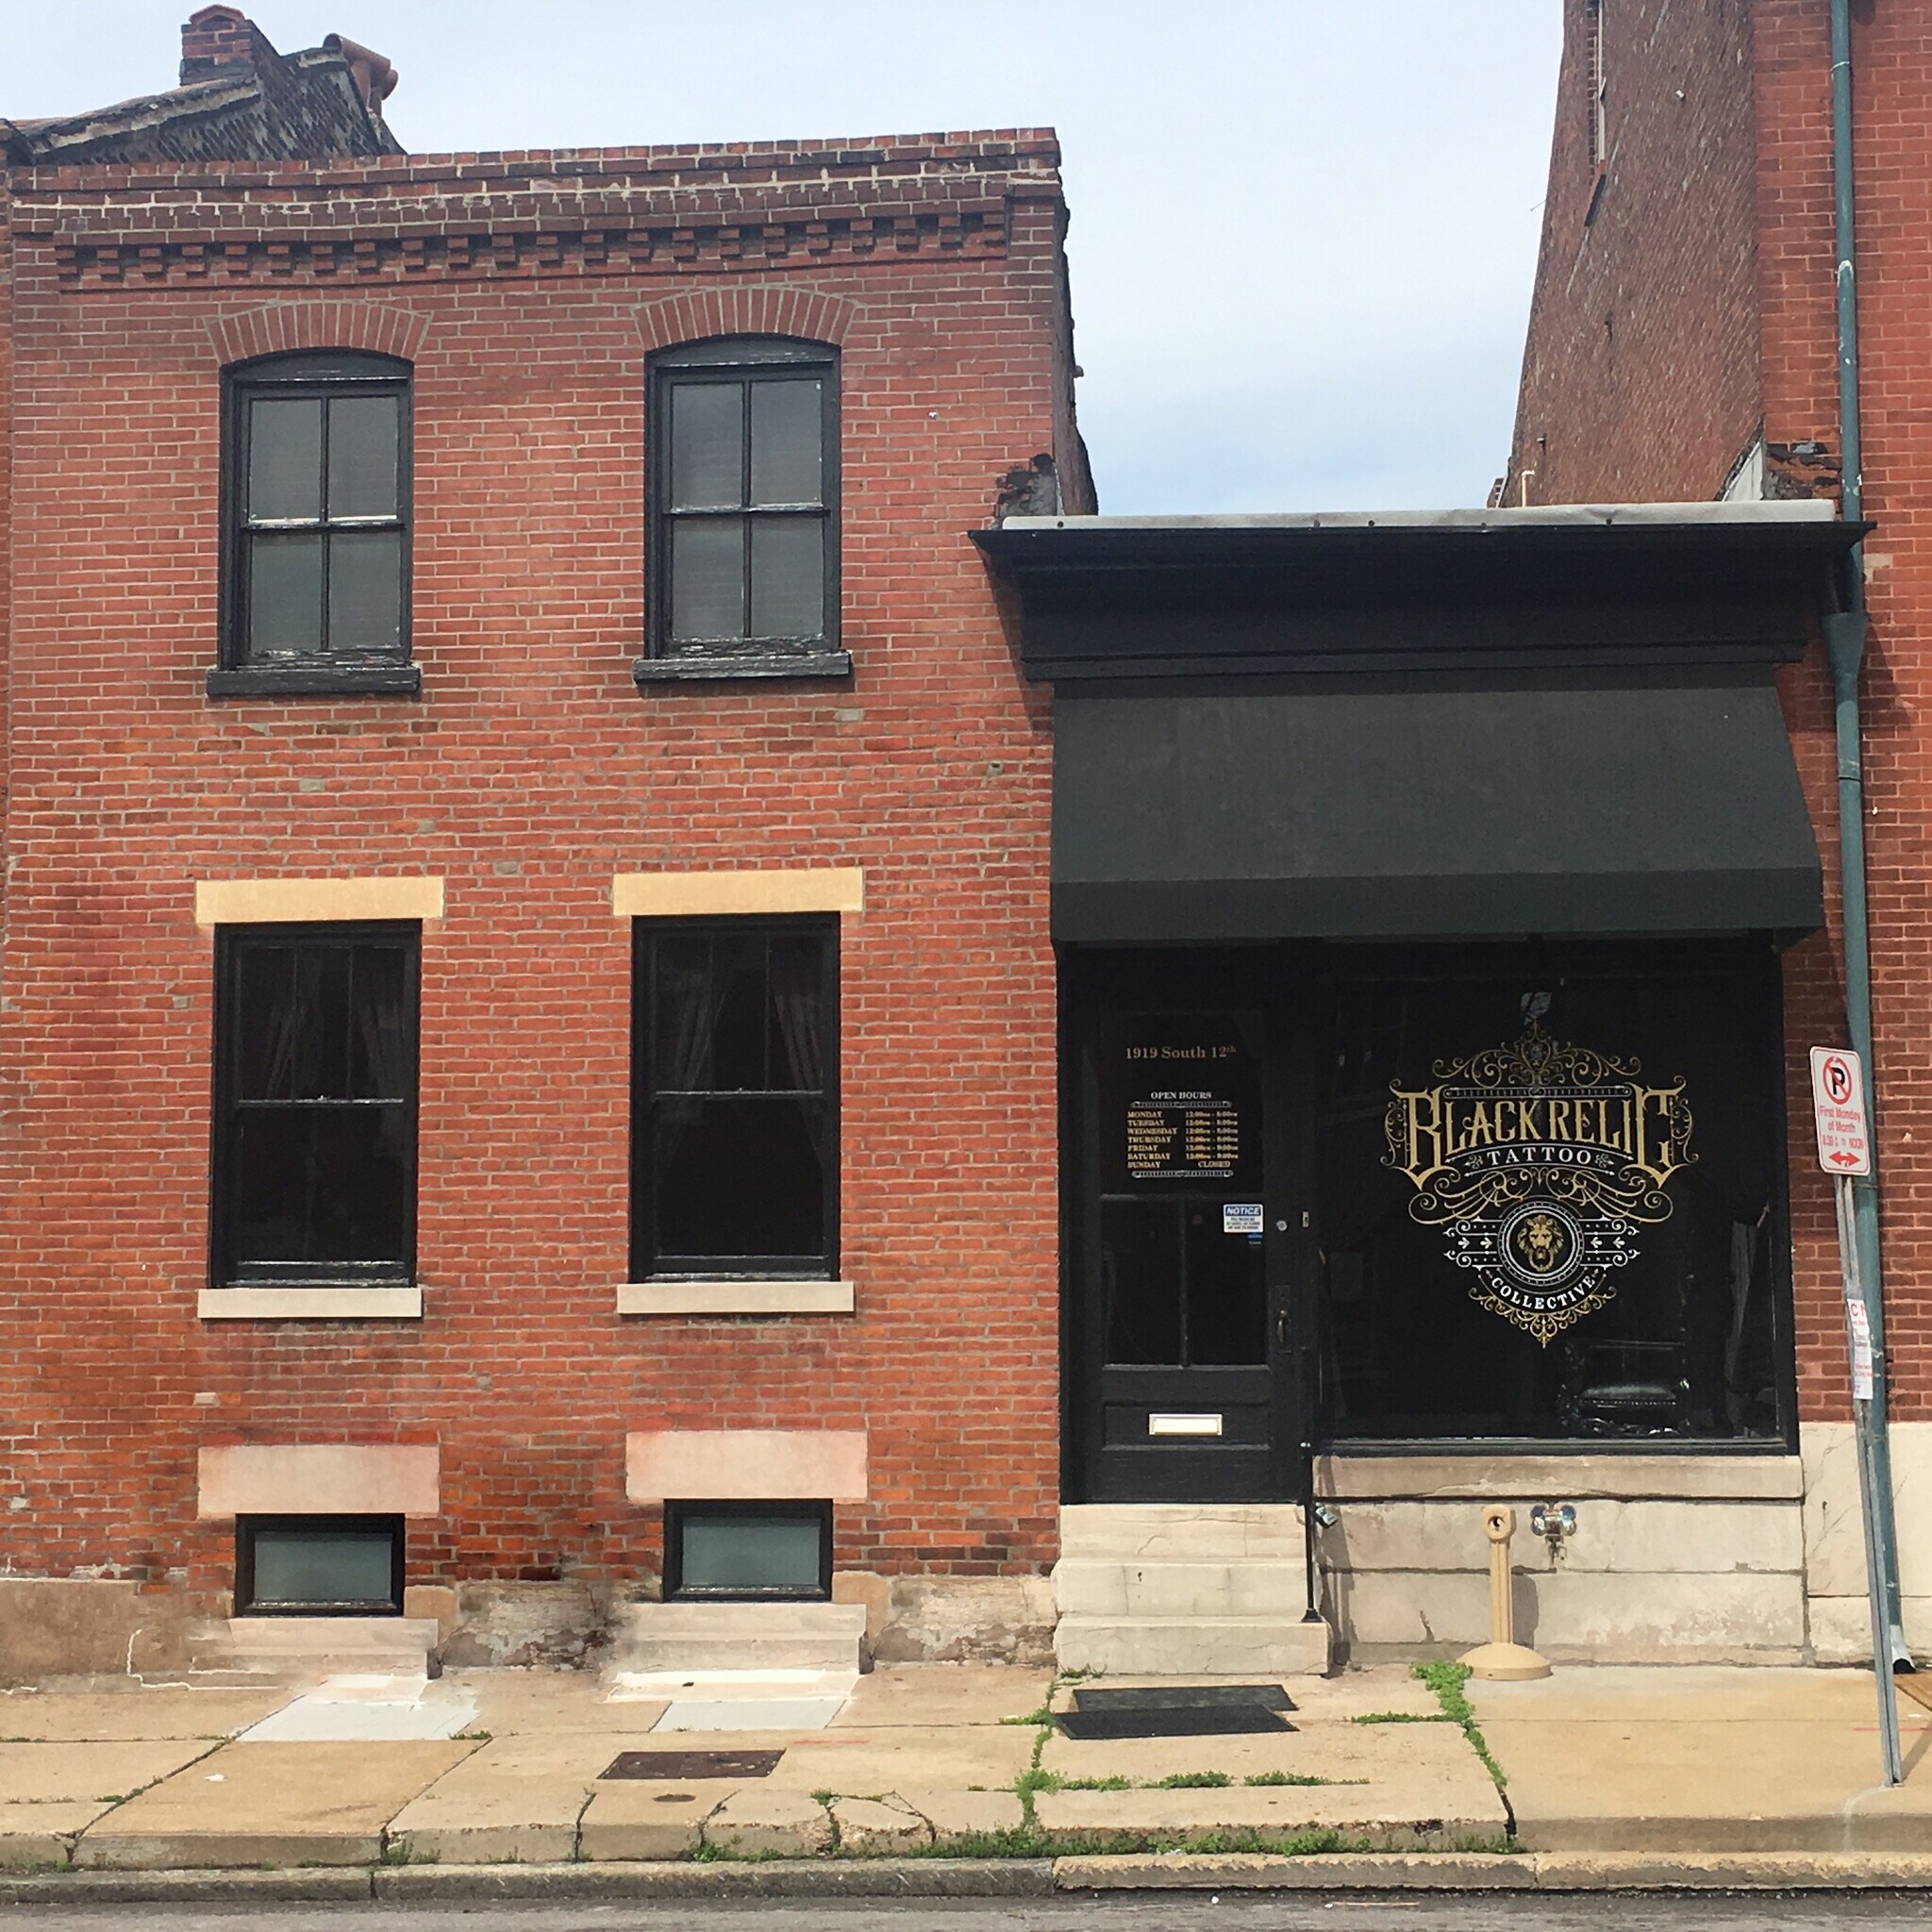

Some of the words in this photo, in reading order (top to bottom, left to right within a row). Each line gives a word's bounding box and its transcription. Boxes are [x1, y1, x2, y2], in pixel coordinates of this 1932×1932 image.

[1125, 1047, 1158, 1059] 1919
[1161, 1045, 1207, 1058] South
[1211, 1044, 1238, 1058] 12th
[1150, 1091, 1177, 1100] OPEN
[1178, 1091, 1212, 1100] HOURS
[1819, 1105, 1835, 1118] First
[1835, 1107, 1861, 1123] Monday
[1389, 1079, 1541, 1191] BLACK
[1548, 1075, 1688, 1190] RELIC
[1835, 1121, 1857, 1133] Month
[1487, 1147, 1592, 1166] TATTOO
[1226, 1207, 1260, 1216] NOTICE
[1491, 1274, 1597, 1310] COLLECTIVE
